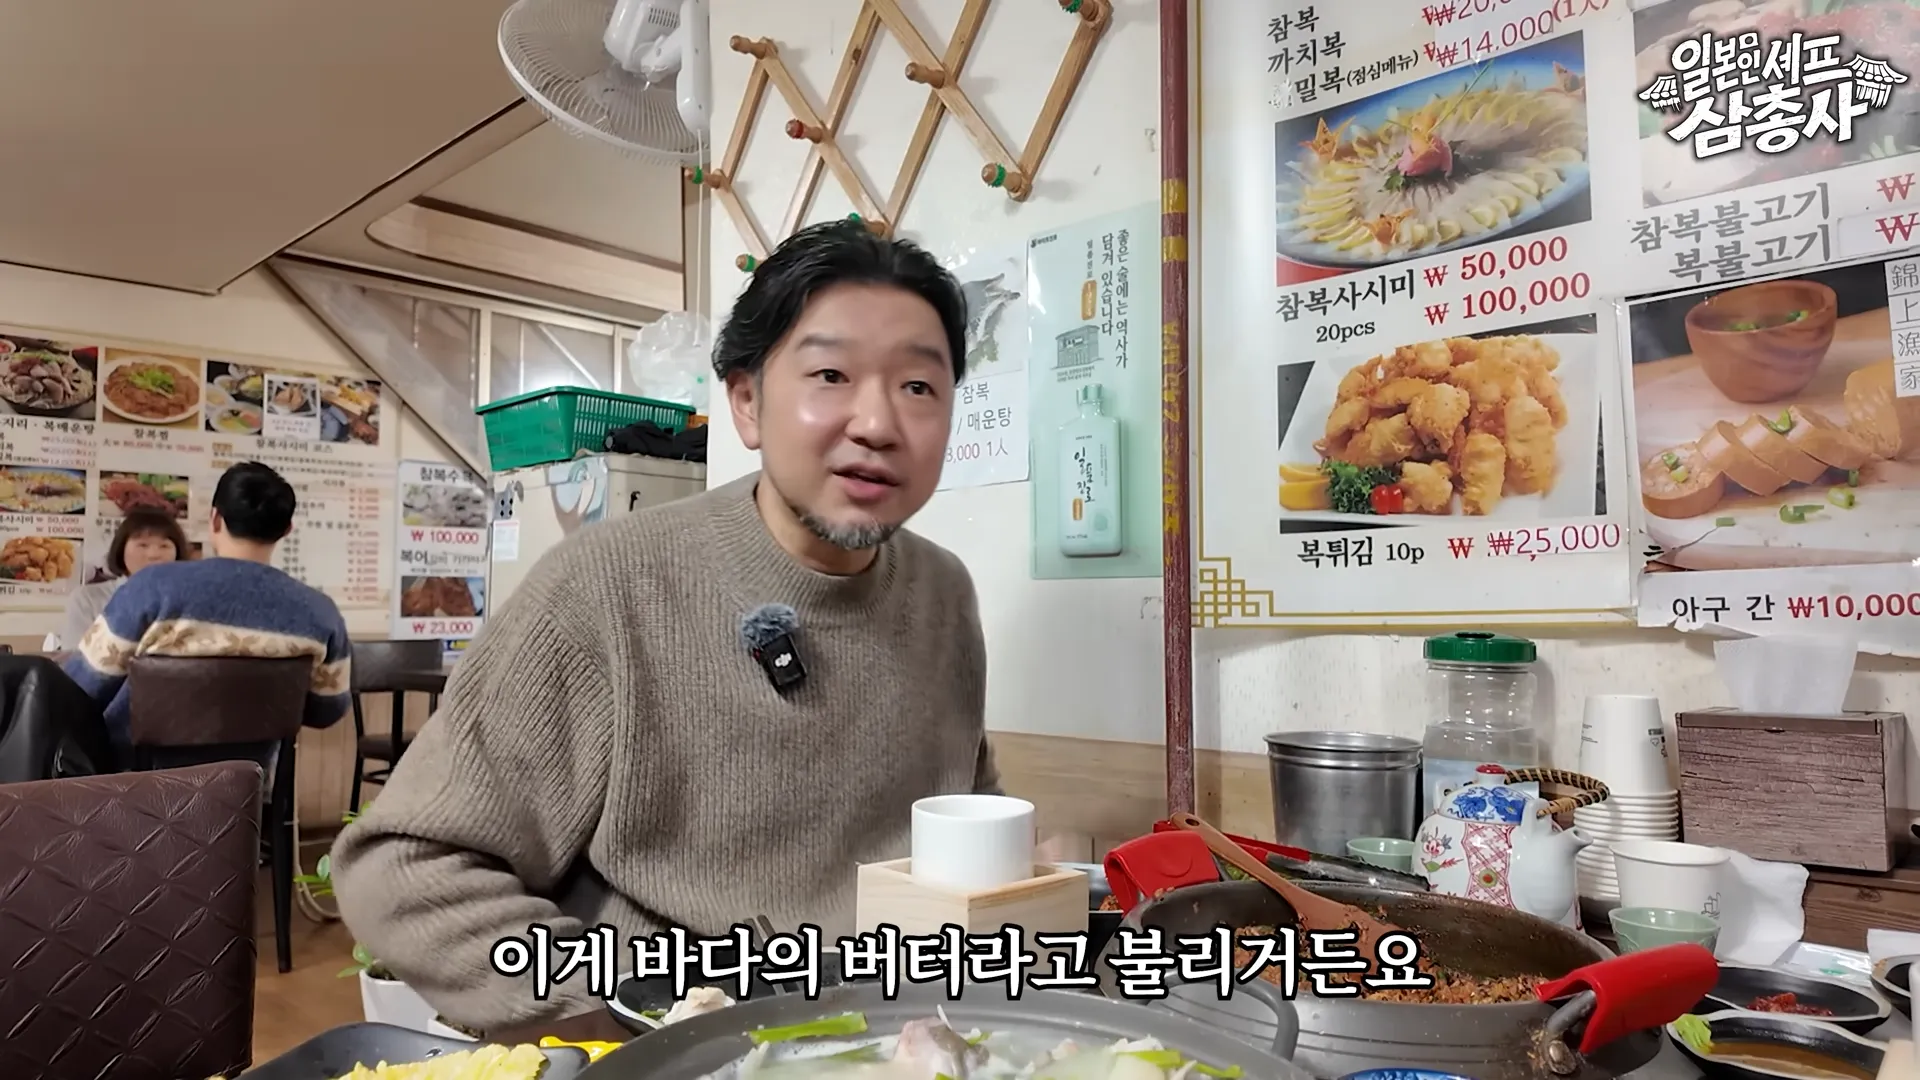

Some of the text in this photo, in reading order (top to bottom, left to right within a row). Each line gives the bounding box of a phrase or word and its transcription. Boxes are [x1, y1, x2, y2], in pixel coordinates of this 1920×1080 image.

[1267, 6, 1319, 43] 참복
[1267, 31, 1346, 75] 까치복
[1268, 50, 1419, 109] 밀복(점심메뉴)
[1630, 173, 1916, 253] 참복불고기 ₩
[1669, 213, 1920, 283] 복불고기 ₩
[1101, 233, 1113, 336] 담겨 있습니다
[1276, 236, 1568, 323] 참복사시미 ₩ 50,000
[1116, 229, 1129, 369] 좋은 술에는 역사가
[1316, 272, 1591, 343] 20pcs ₩ 100,000
[962, 382, 990, 405] 참복
[0, 417, 28, 430] 지리
[967, 407, 1012, 431] 매운탕
[0, 515, 33, 524] 사시미
[430, 531, 479, 545] 100,000
[1297, 536, 1373, 568] 복튀김
[1386, 542, 1425, 563] 10p
[1672, 596, 1731, 623] 아구
[1746, 594, 1776, 621] 간
[430, 622, 473, 634] 23,000
